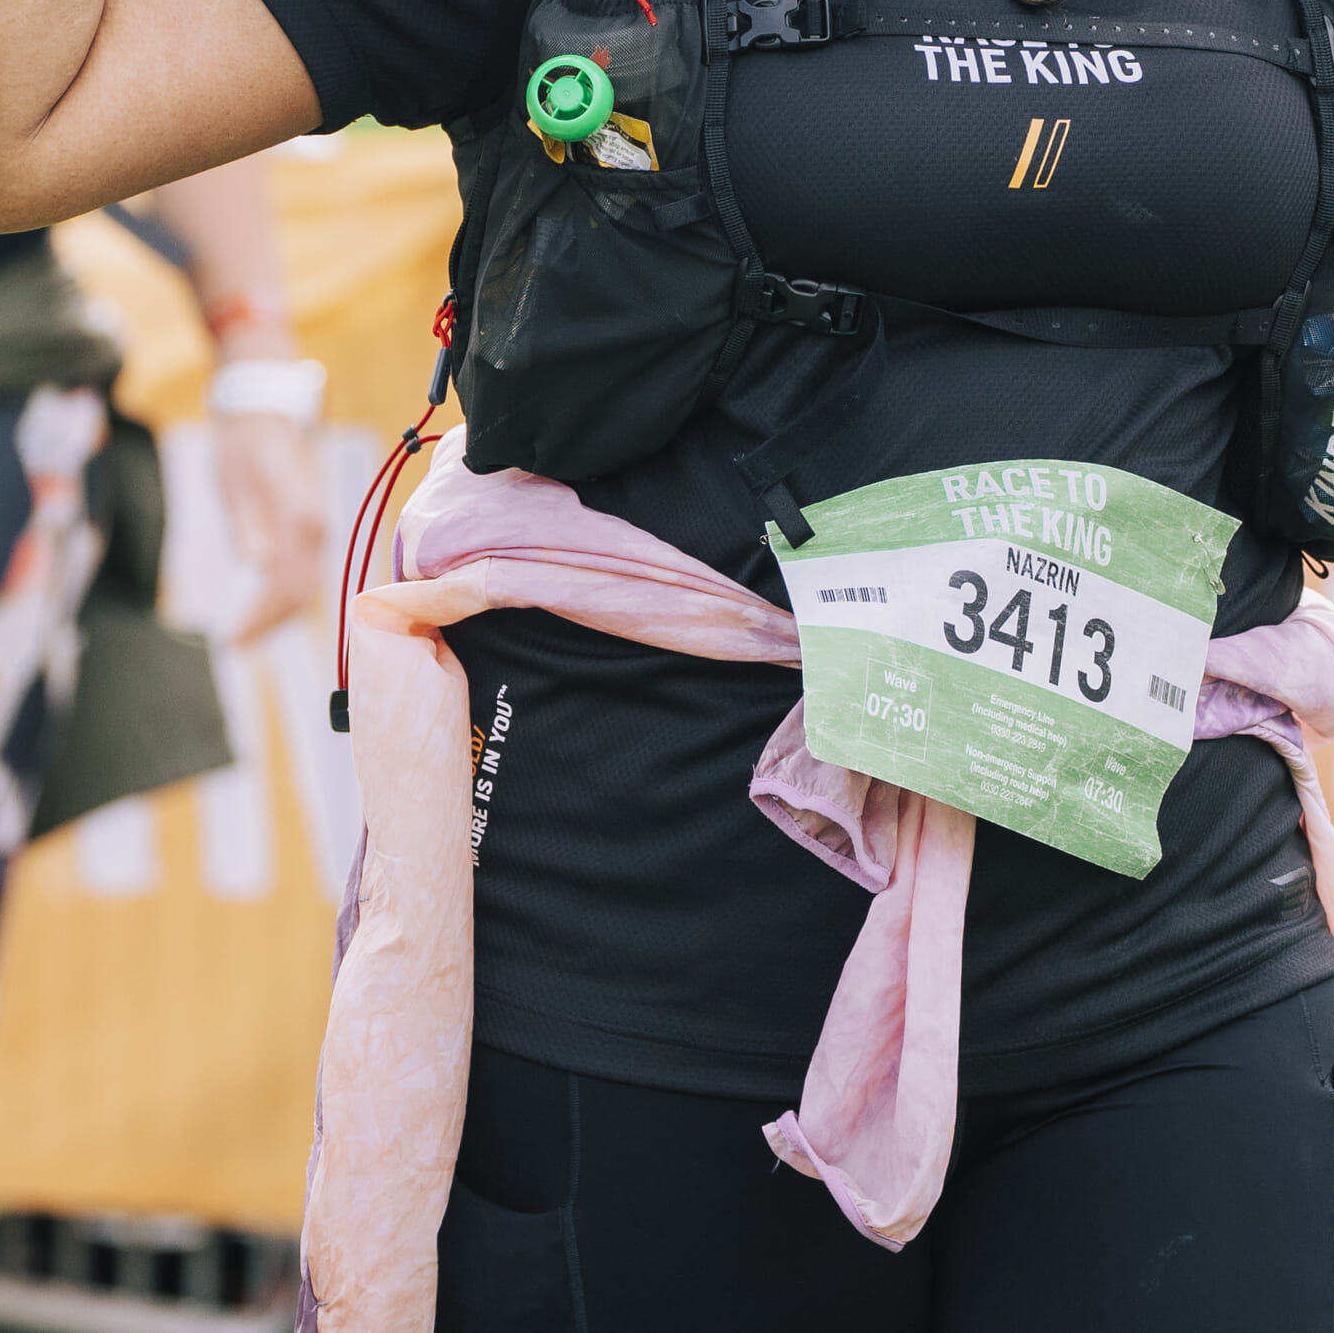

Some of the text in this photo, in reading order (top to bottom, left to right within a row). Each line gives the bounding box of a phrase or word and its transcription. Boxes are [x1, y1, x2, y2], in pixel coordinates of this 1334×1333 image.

[914, 44, 1144, 85] THE KING
[941, 467, 1108, 512] RACE TO
[951, 502, 1113, 567] THE KING
[1006, 546, 1081, 597] NAZRIN
[943, 569, 1116, 703] 3413
[883, 669, 918, 693] Wave
[867, 692, 926, 732] 07:30
[481, 748, 502, 775] IN
[1105, 755, 1127, 776] Wave
[474, 778, 493, 802] IS
[1084, 776, 1124, 813] 07:30
